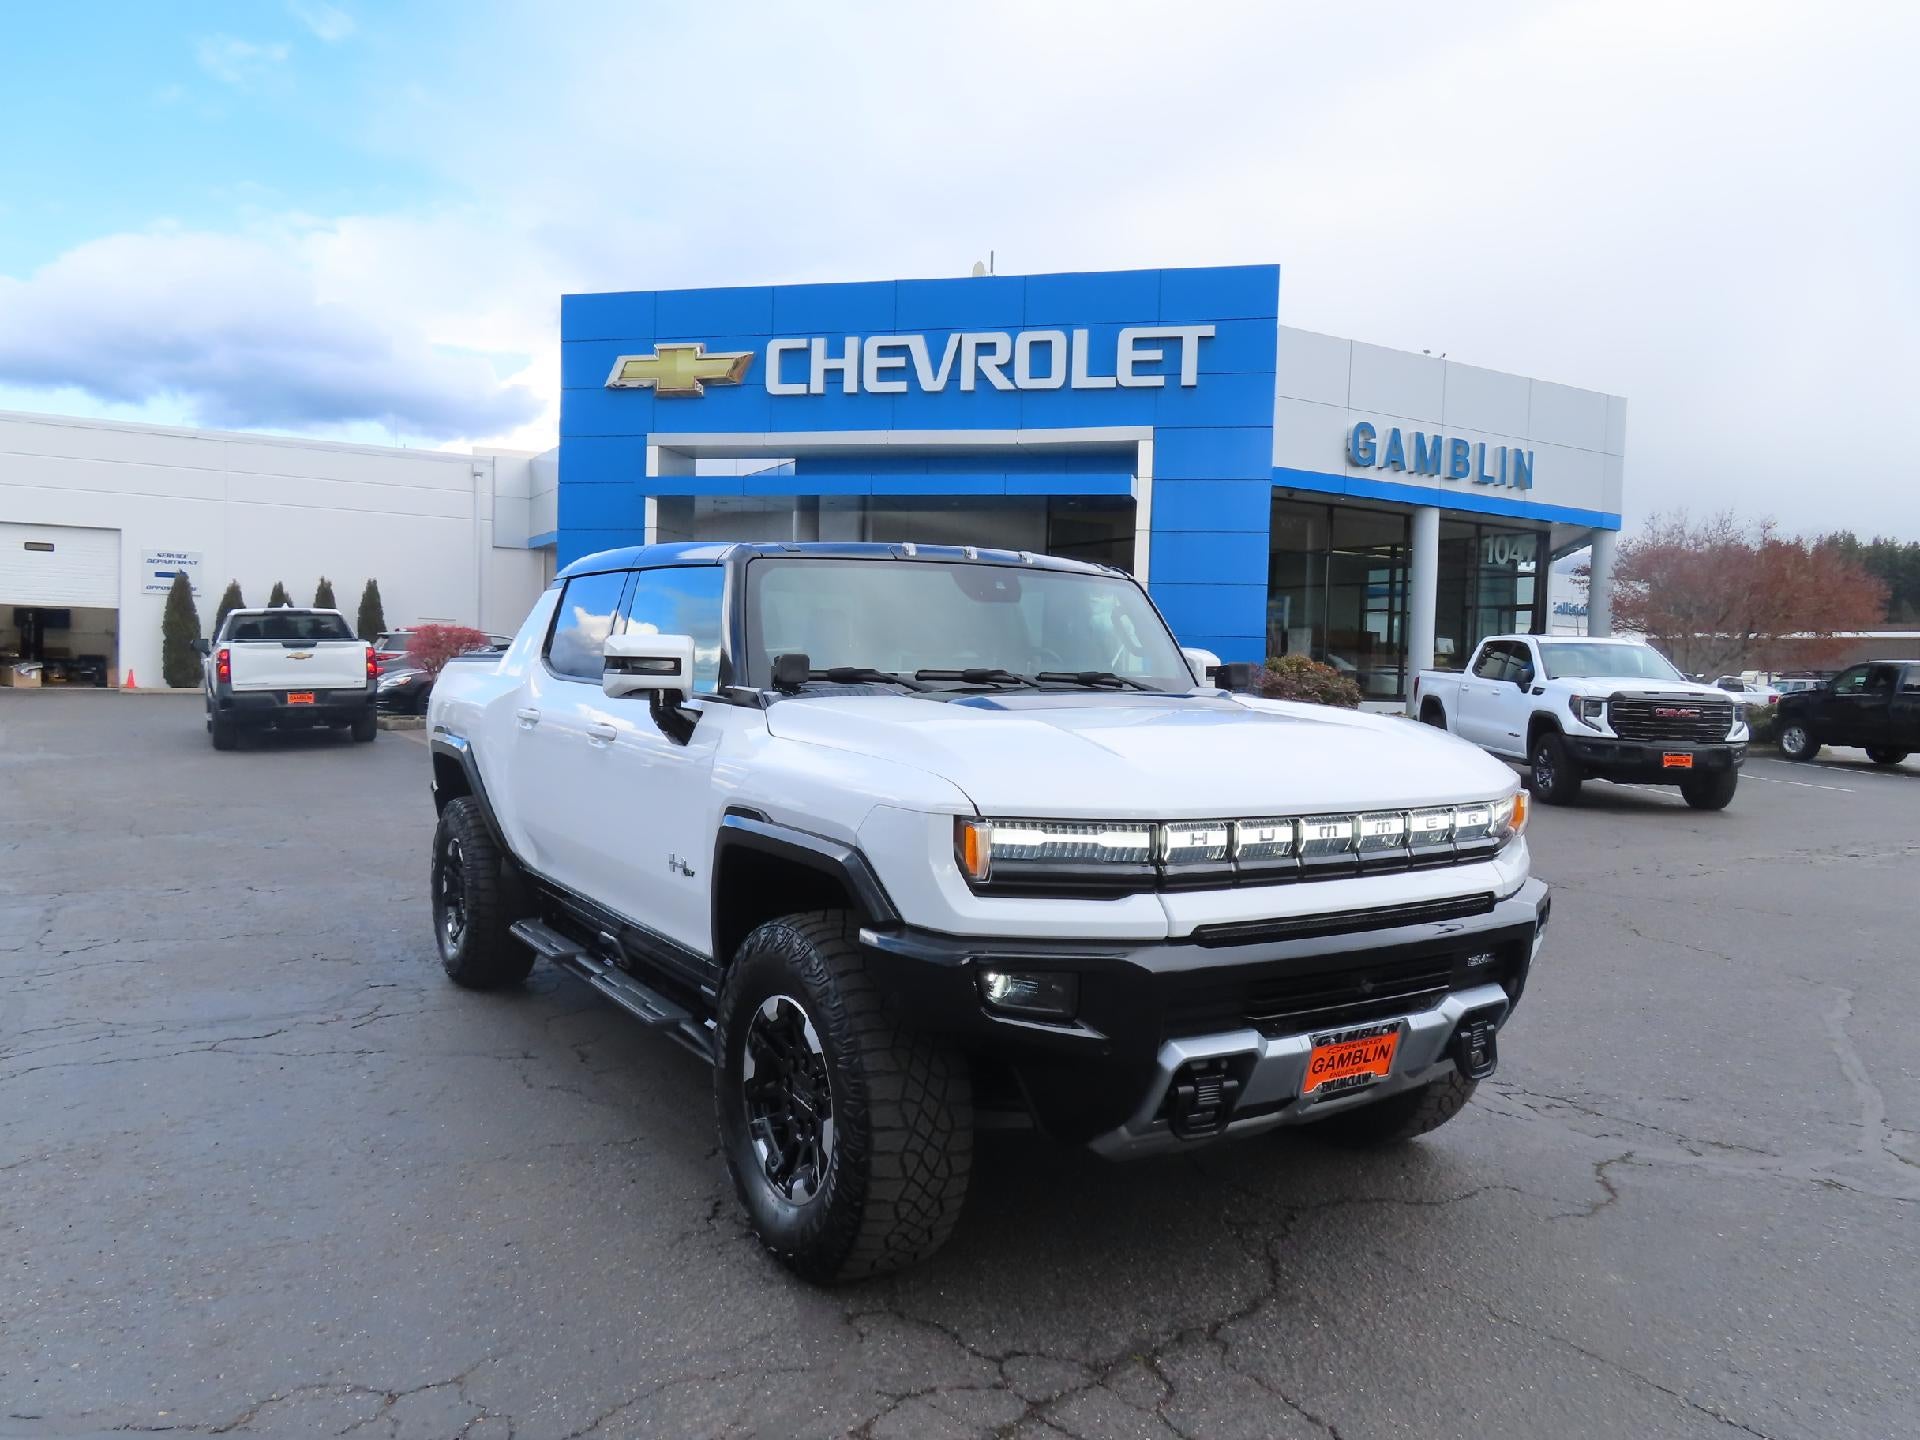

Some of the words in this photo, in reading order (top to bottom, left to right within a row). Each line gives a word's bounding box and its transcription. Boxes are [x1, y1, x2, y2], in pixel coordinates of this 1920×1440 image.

[766, 325, 1216, 395] CHEVROLET
[1348, 421, 1534, 490] GAMBLIN
[1486, 536, 1535, 566] 1047
[1655, 707, 1700, 718] GMC
[1312, 1043, 1391, 1075] GAMBLIN
